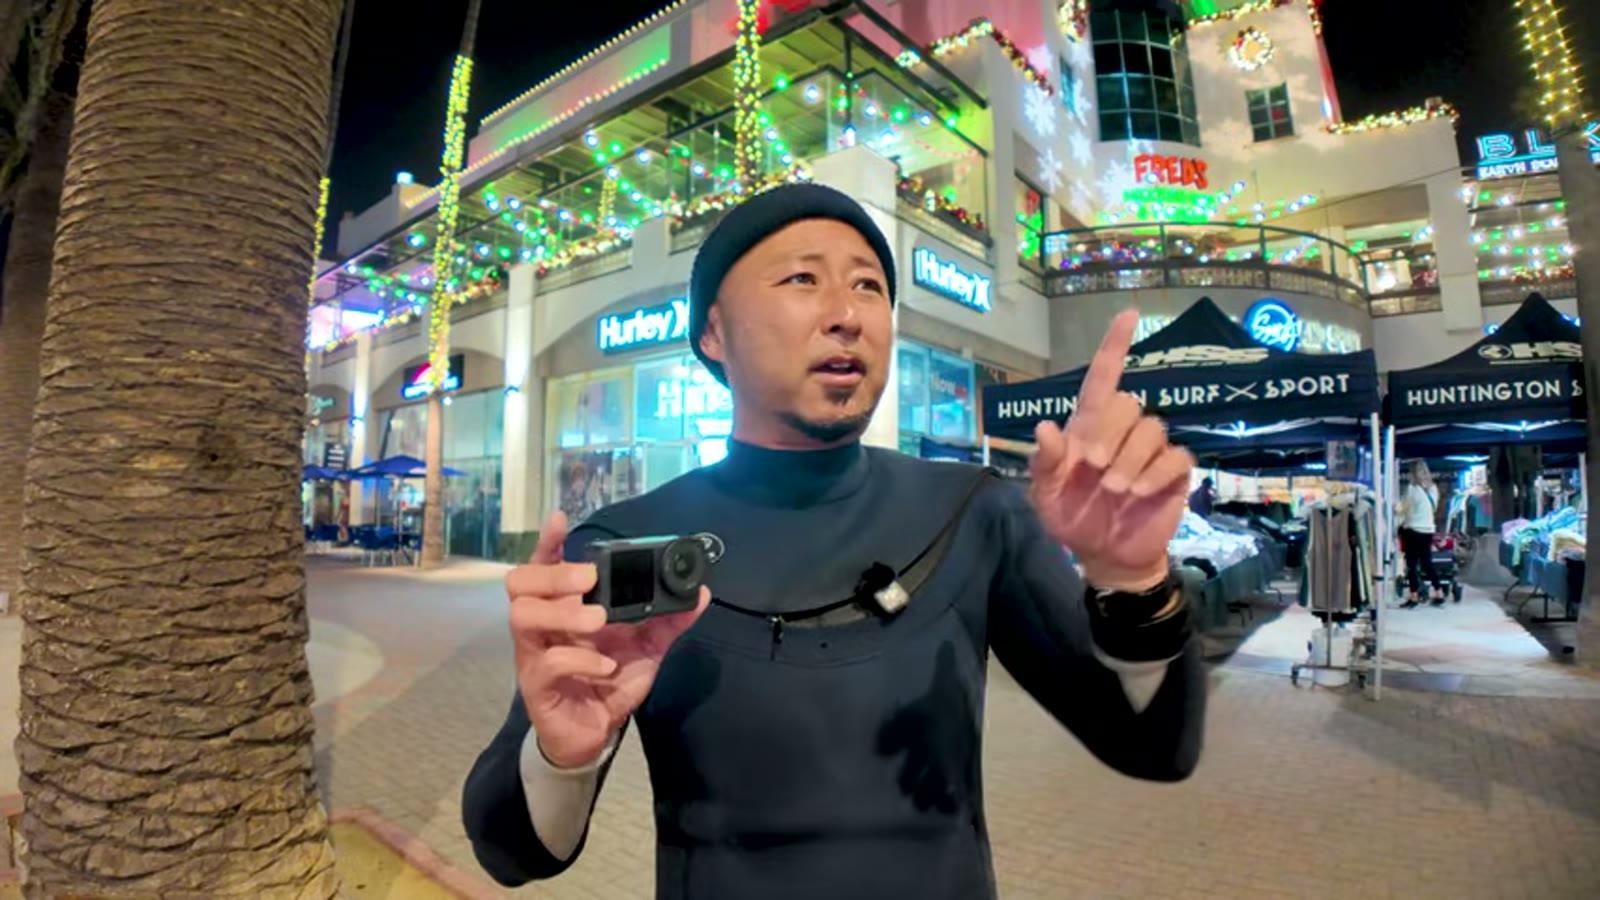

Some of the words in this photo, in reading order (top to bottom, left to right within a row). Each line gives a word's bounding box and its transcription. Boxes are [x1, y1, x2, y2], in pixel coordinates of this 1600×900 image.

[599, 309, 674, 350] Hurley
[1158, 384, 1222, 407] SURF
[1264, 374, 1350, 399] SPORT
[1407, 379, 1561, 406] HUNTINGTON
